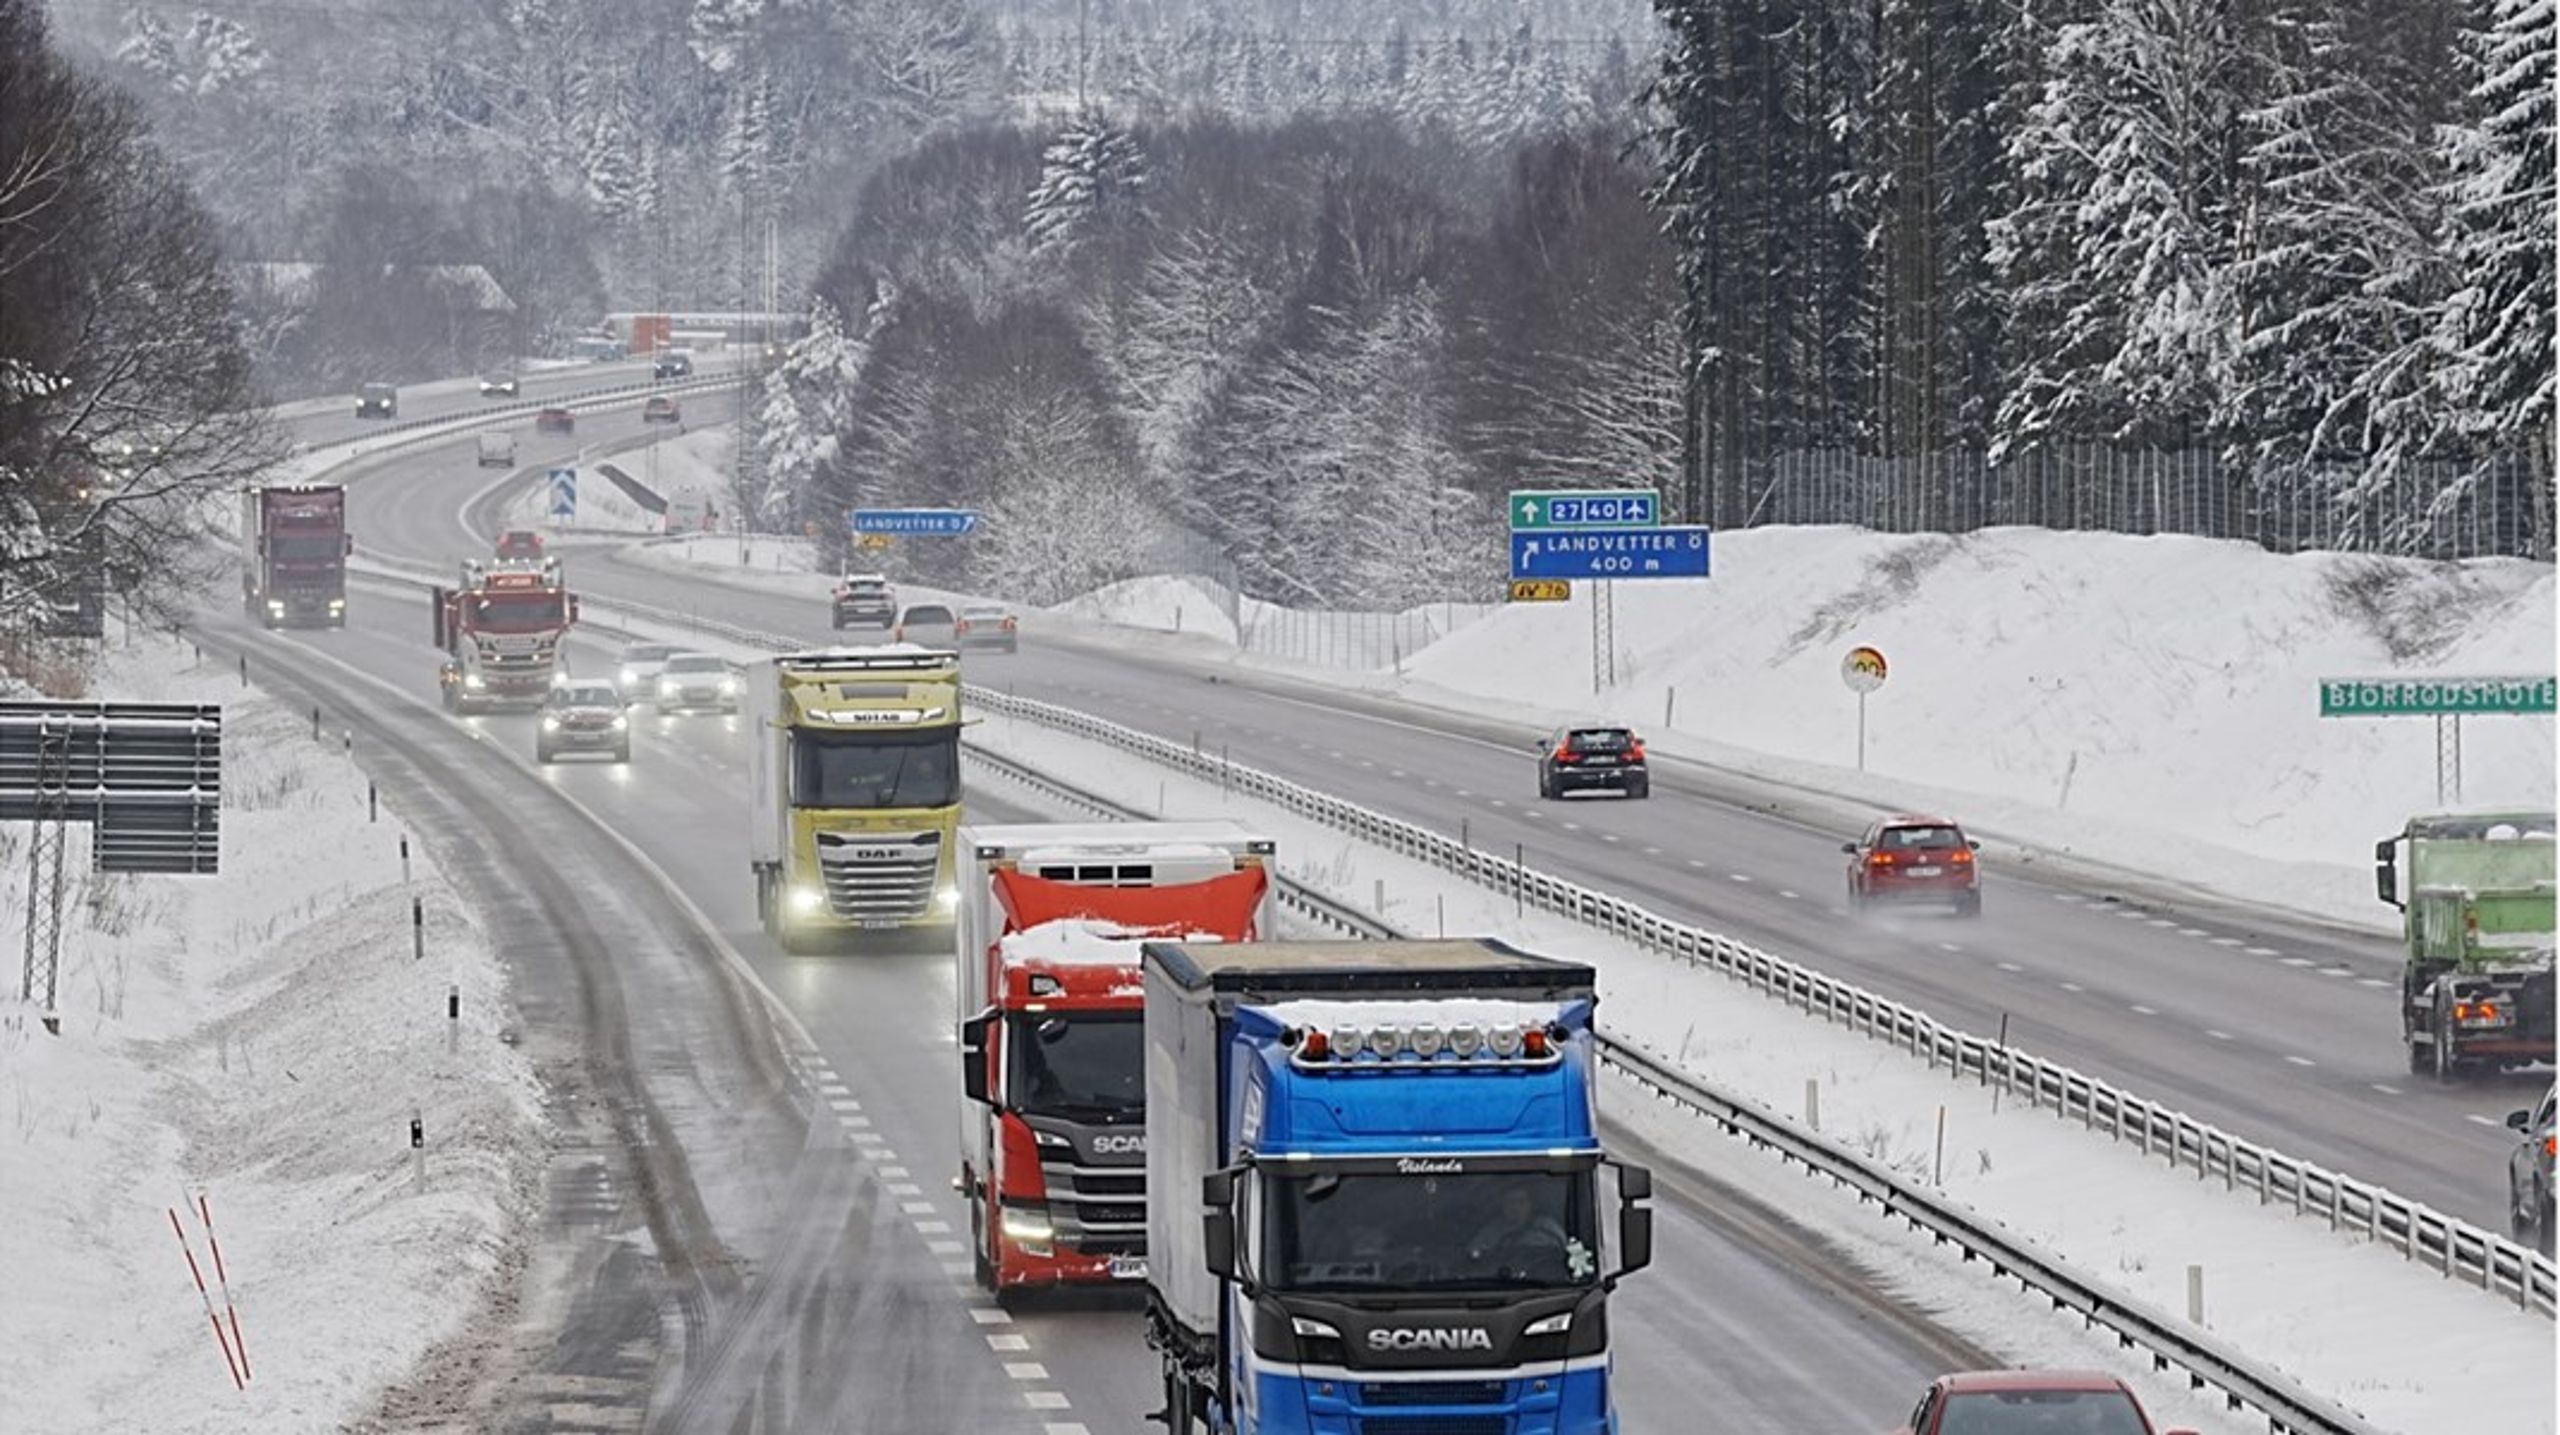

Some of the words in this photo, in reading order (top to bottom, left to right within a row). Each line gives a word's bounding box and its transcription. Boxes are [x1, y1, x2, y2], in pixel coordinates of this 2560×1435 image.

[1554, 503, 1579, 518] 27
[1588, 503, 1617, 518] 40
[858, 518, 944, 530] LANDVETTER
[1547, 536, 1677, 551] LANDVETTER
[1688, 532, 1702, 549] Ö
[1590, 556, 1633, 571] 400
[1645, 557, 1660, 571] m
[857, 849, 902, 859] DAF
[1093, 1135, 1147, 1153] SCA
[1367, 1328, 1492, 1350] SCANIA
